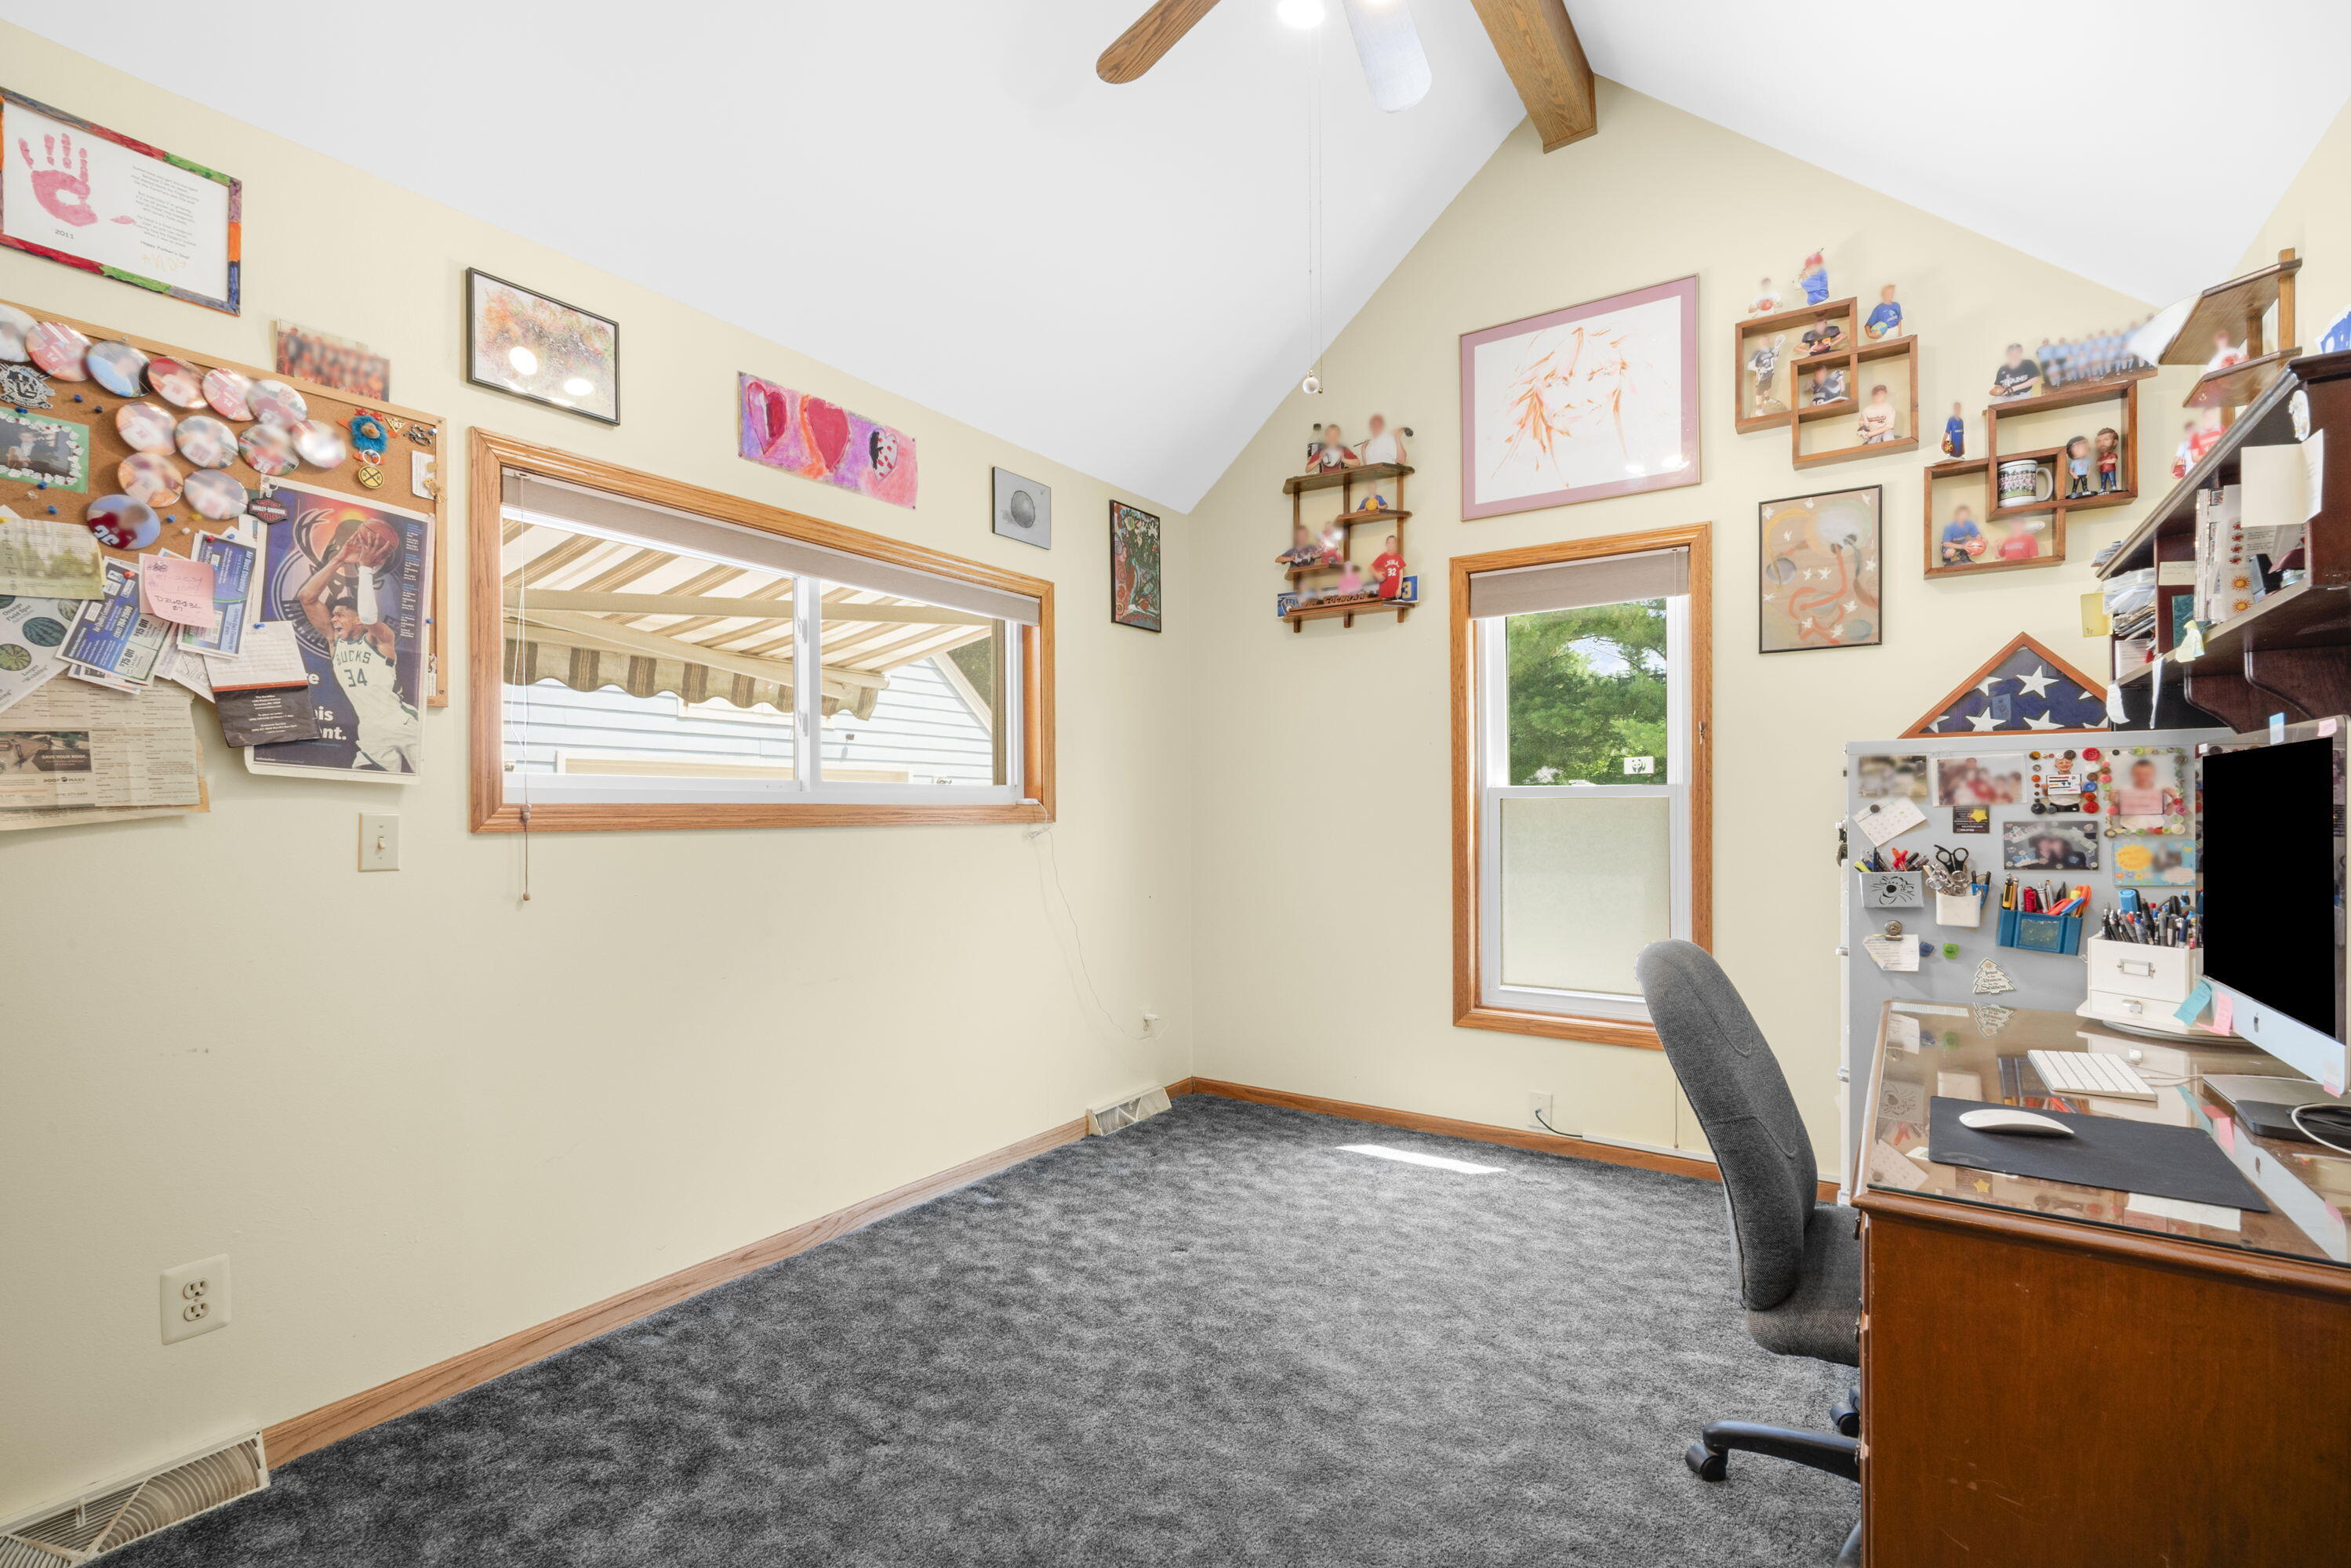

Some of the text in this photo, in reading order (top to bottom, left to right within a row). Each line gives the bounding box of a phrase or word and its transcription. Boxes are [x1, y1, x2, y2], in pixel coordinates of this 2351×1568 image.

[55, 229, 74, 239] 2011
[1387, 568, 1397, 577] 32
[337, 650, 371, 666] BUCKS
[344, 668, 368, 688] 34
